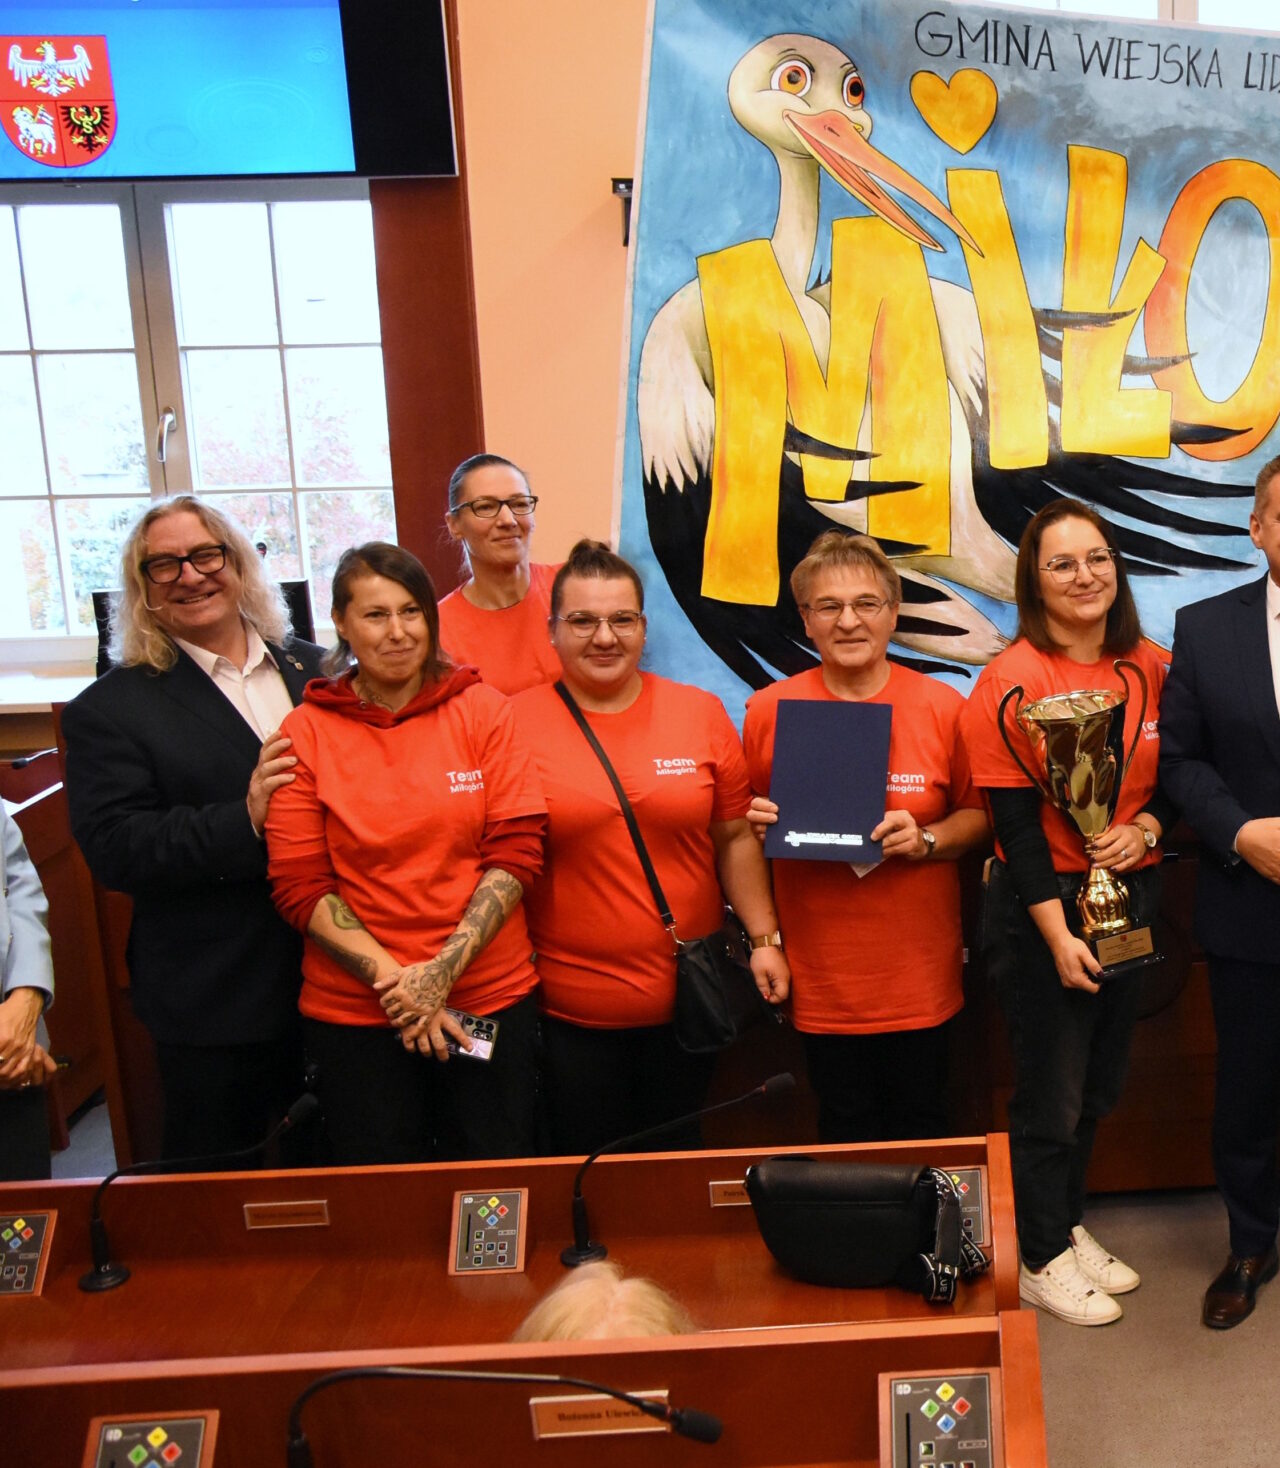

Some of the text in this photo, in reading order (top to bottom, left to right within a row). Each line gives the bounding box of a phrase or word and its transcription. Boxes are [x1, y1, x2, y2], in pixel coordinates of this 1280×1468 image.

[914, 11, 1057, 72] GMINA
[1072, 32, 1223, 89] WIEJSKA
[653, 758, 696, 768] Team
[887, 772, 925, 783] eam
